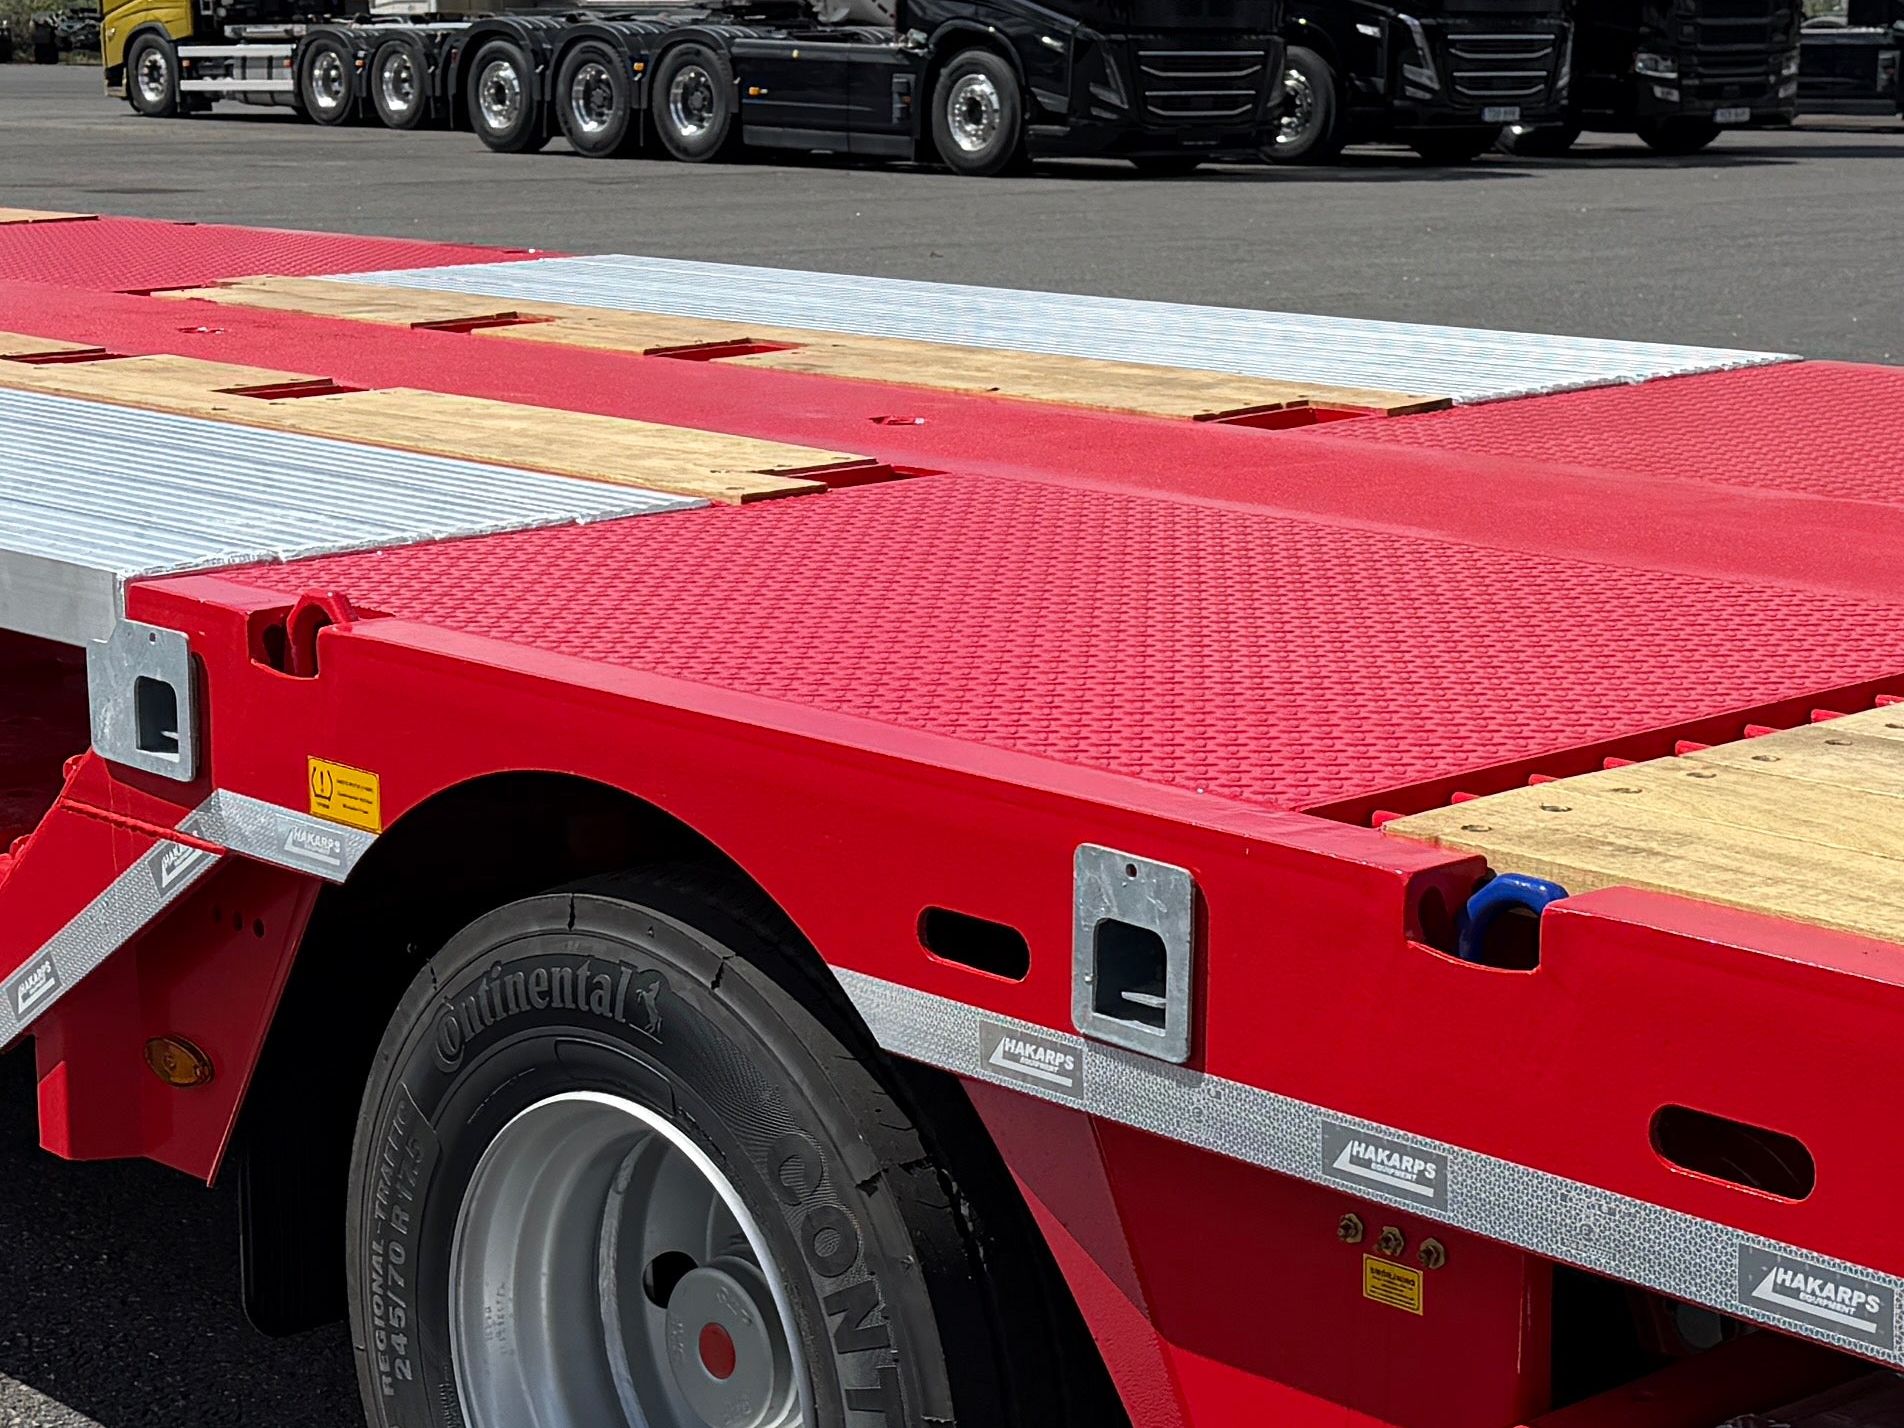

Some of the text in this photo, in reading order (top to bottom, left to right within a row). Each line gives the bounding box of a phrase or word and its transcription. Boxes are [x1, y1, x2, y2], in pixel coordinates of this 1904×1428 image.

[293, 826, 341, 853] HAKARPS
[434, 958, 634, 1072] Continental
[1004, 1037, 1075, 1071] HAKARPS
[1351, 1139, 1437, 1180] HAKARPS
[1776, 1267, 1881, 1314] HAKARPS
[1798, 1291, 1857, 1316] EQUIPMENT
